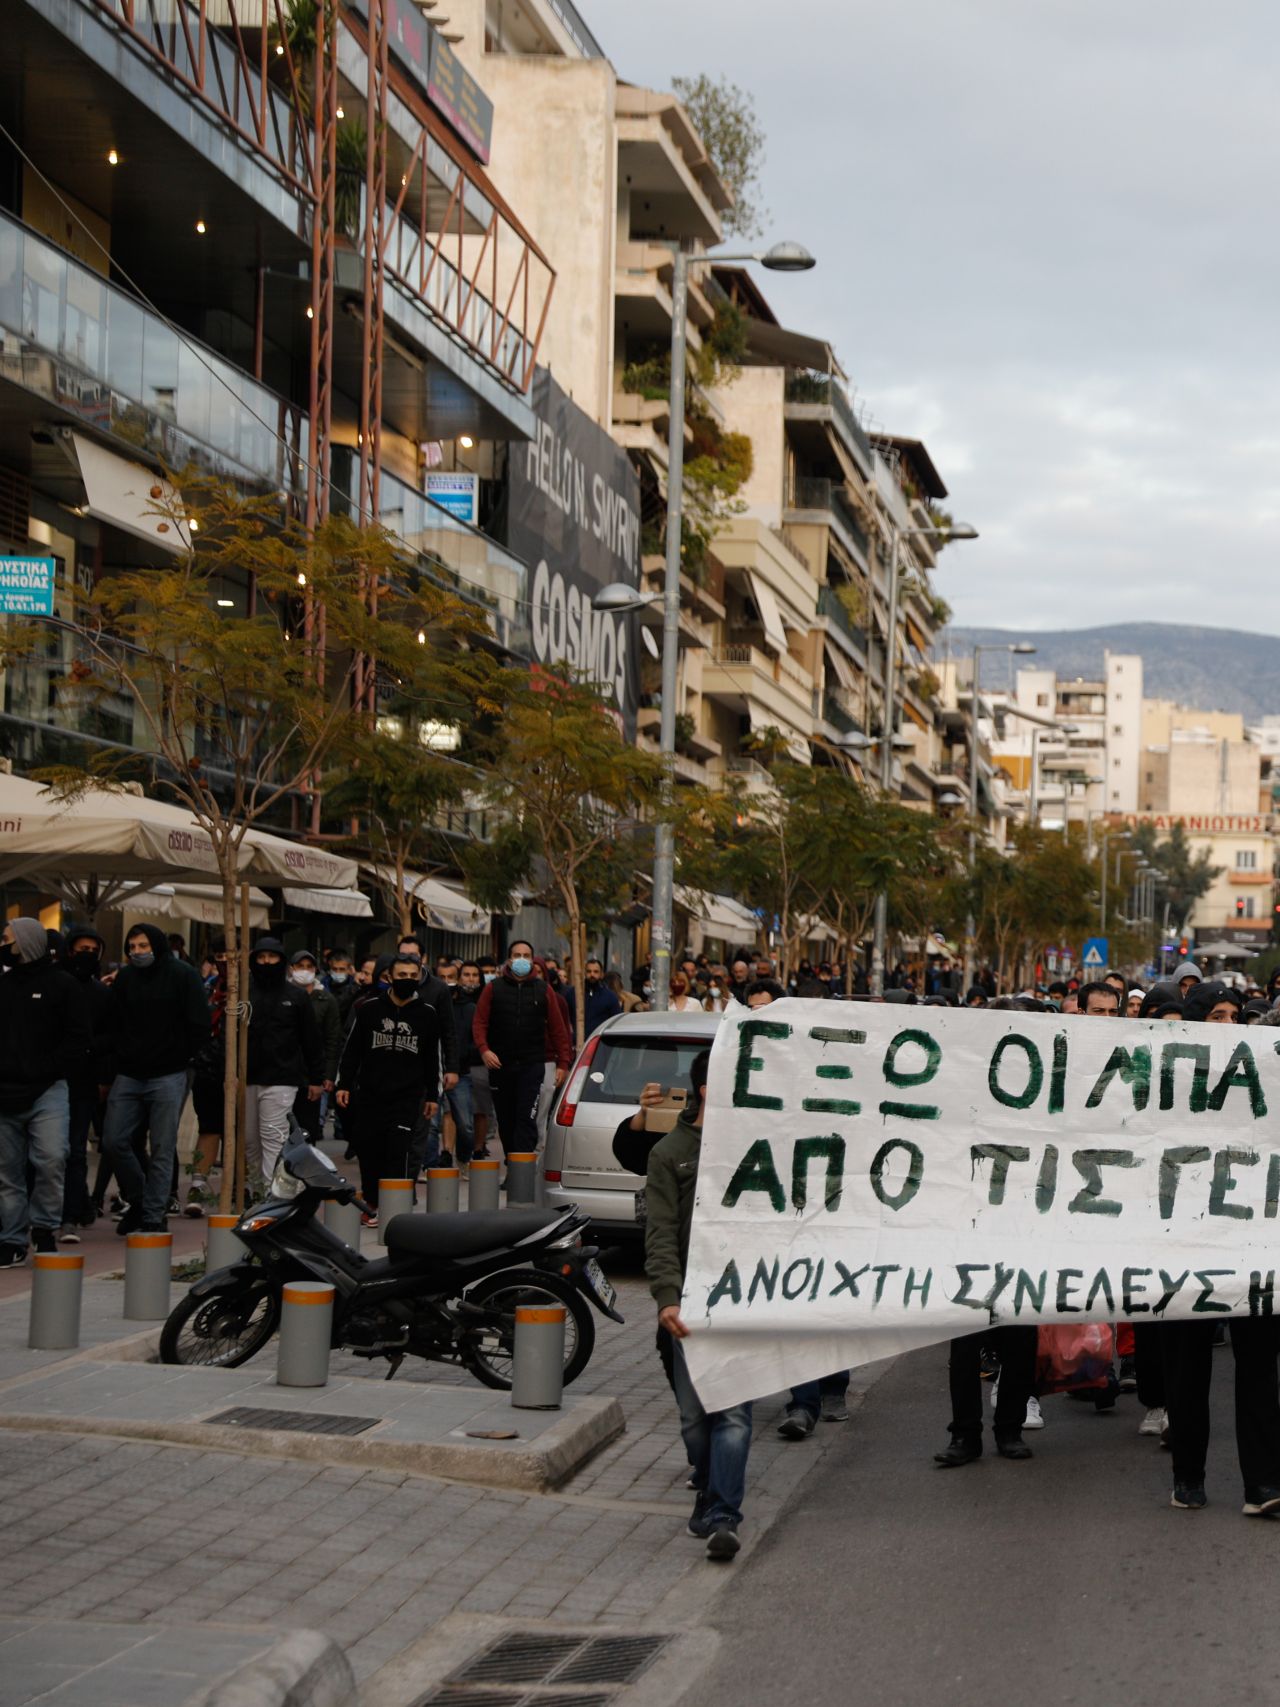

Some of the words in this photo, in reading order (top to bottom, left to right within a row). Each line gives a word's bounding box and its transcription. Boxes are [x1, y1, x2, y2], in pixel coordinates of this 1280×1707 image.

[0, 574, 49, 589] ΗΚΟΪΑΣ
[532, 559, 626, 711] COSMOS
[0, 817, 22, 832] ni
[732, 1019, 942, 1120] ΕΞΩ
[987, 1033, 1068, 1114] ΟΙ
[721, 1132, 925, 1214] ΑΠΟ
[970, 1143, 1145, 1217] ΤΙΣ
[706, 1257, 933, 1310] ΑΝΟΙΧΤΗ
[950, 1261, 1275, 1320] ΣΥΝΕΛΕΥΣΗ
